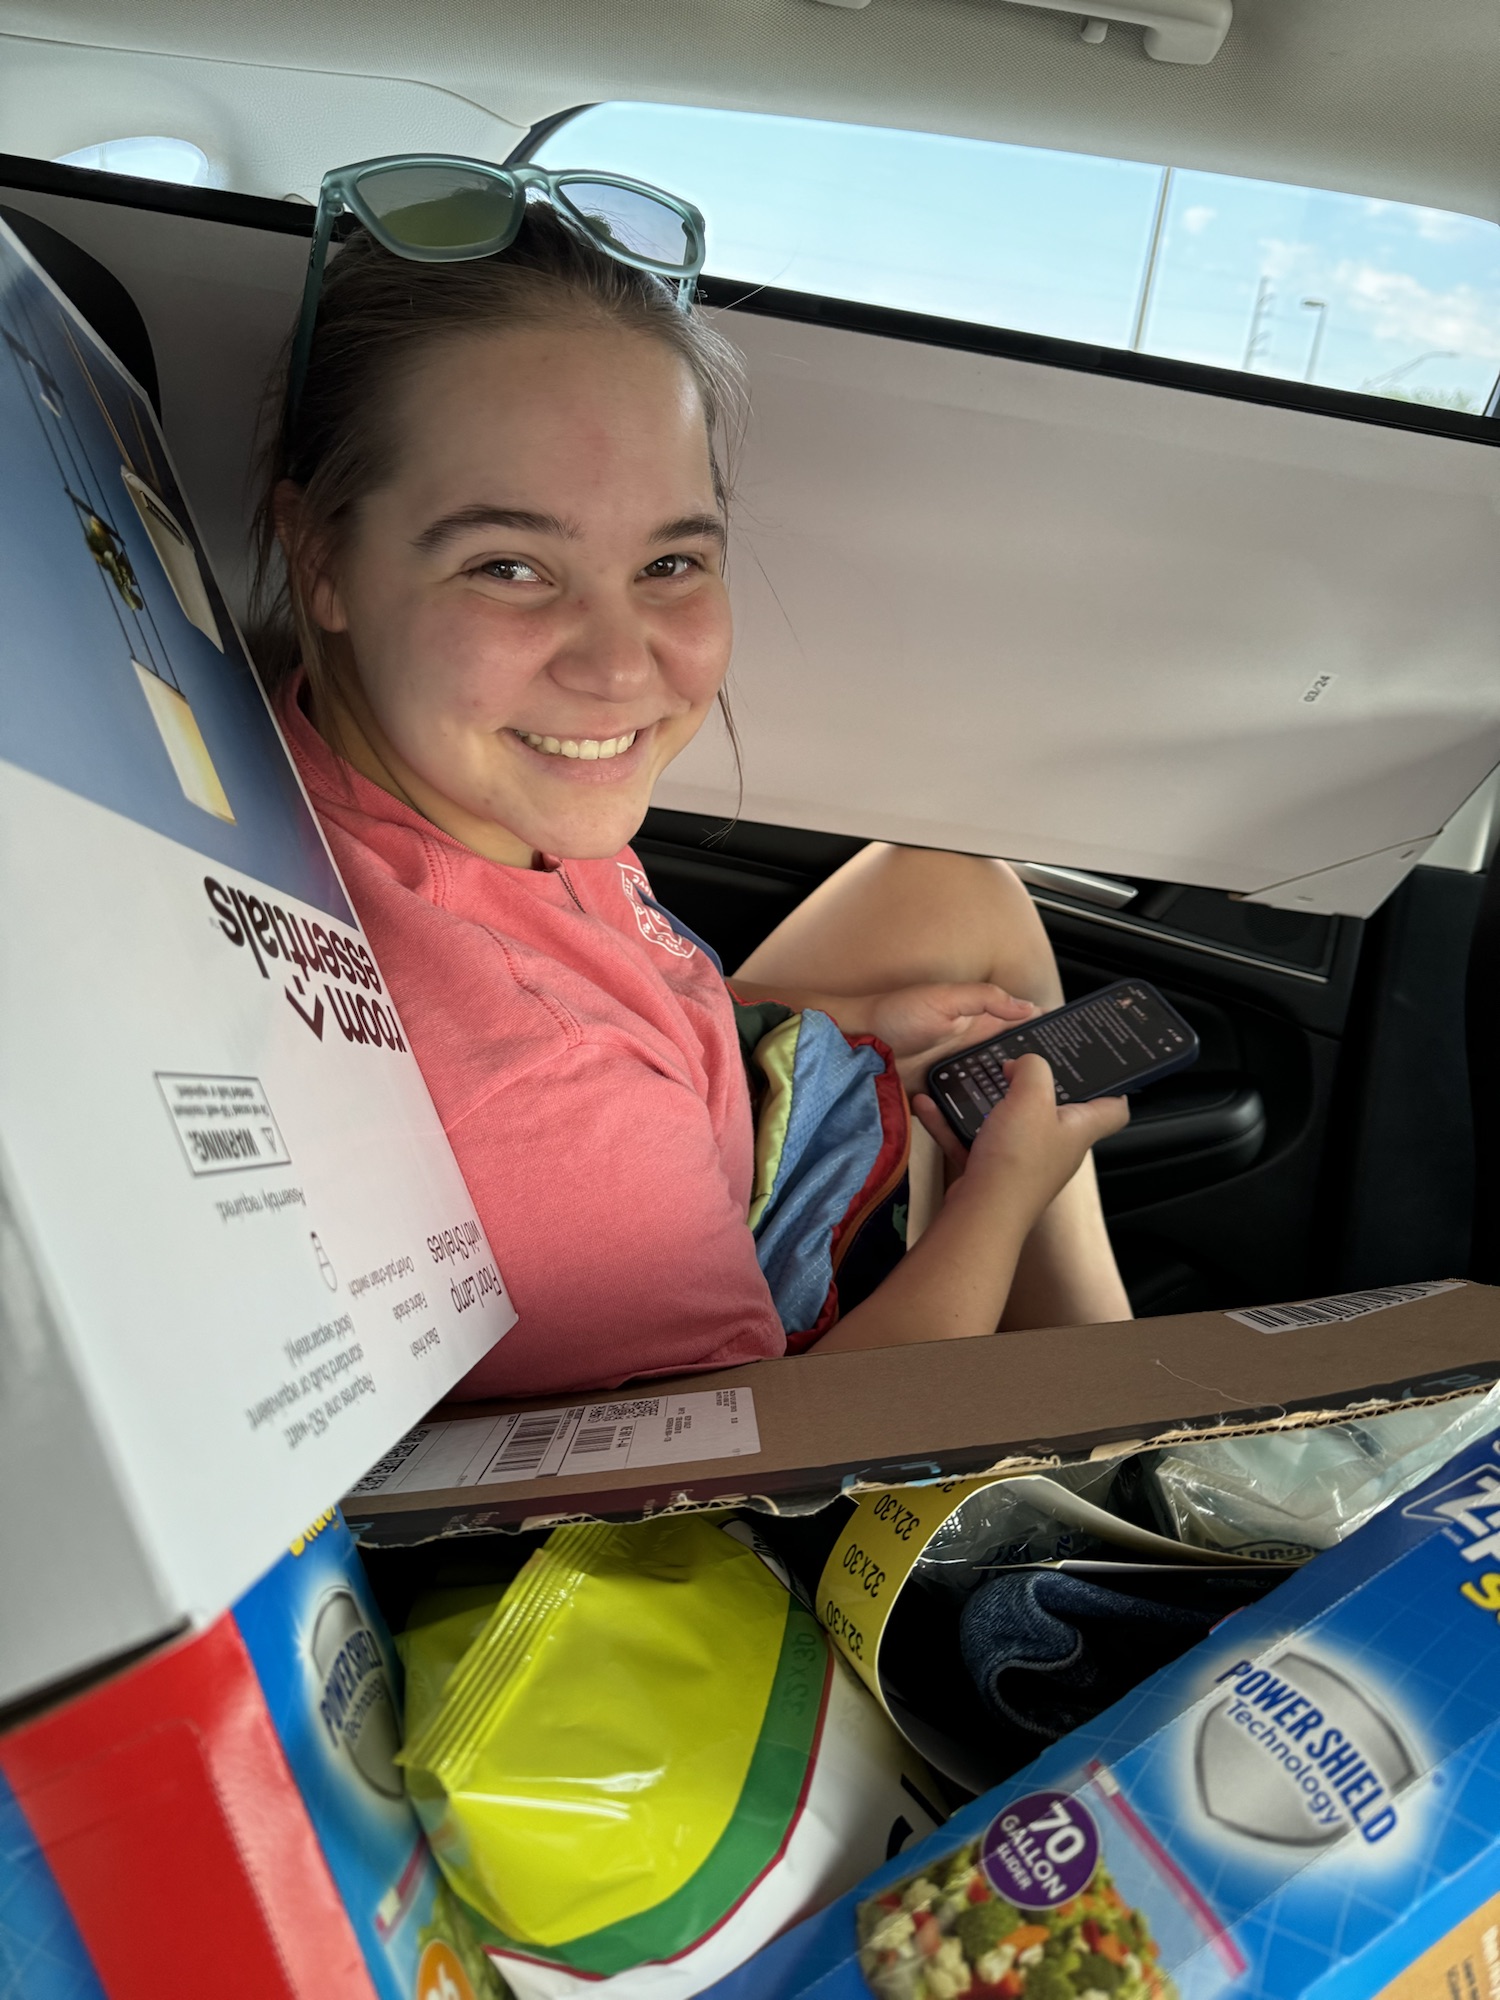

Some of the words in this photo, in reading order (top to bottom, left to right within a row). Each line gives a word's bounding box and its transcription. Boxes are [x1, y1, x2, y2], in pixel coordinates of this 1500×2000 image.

[203, 876, 382, 995] essentials
[323, 984, 408, 1053] room
[426, 1225, 470, 1266] Shelves
[450, 1276, 484, 1313] Lamp
[476, 1264, 502, 1297] Floor
[873, 1494, 920, 1541] 32x30
[843, 1544, 885, 1598] 32x30
[825, 1601, 864, 1661] 32x30
[1214, 1660, 1324, 1742] POWER
[1305, 1727, 1398, 1844] SHIELD
[1226, 1699, 1342, 1826] Technology
[1000, 1814, 1068, 1900] GALLON
[1028, 1800, 1085, 1864] 70
[996, 1841, 1033, 1891] SLIDER
